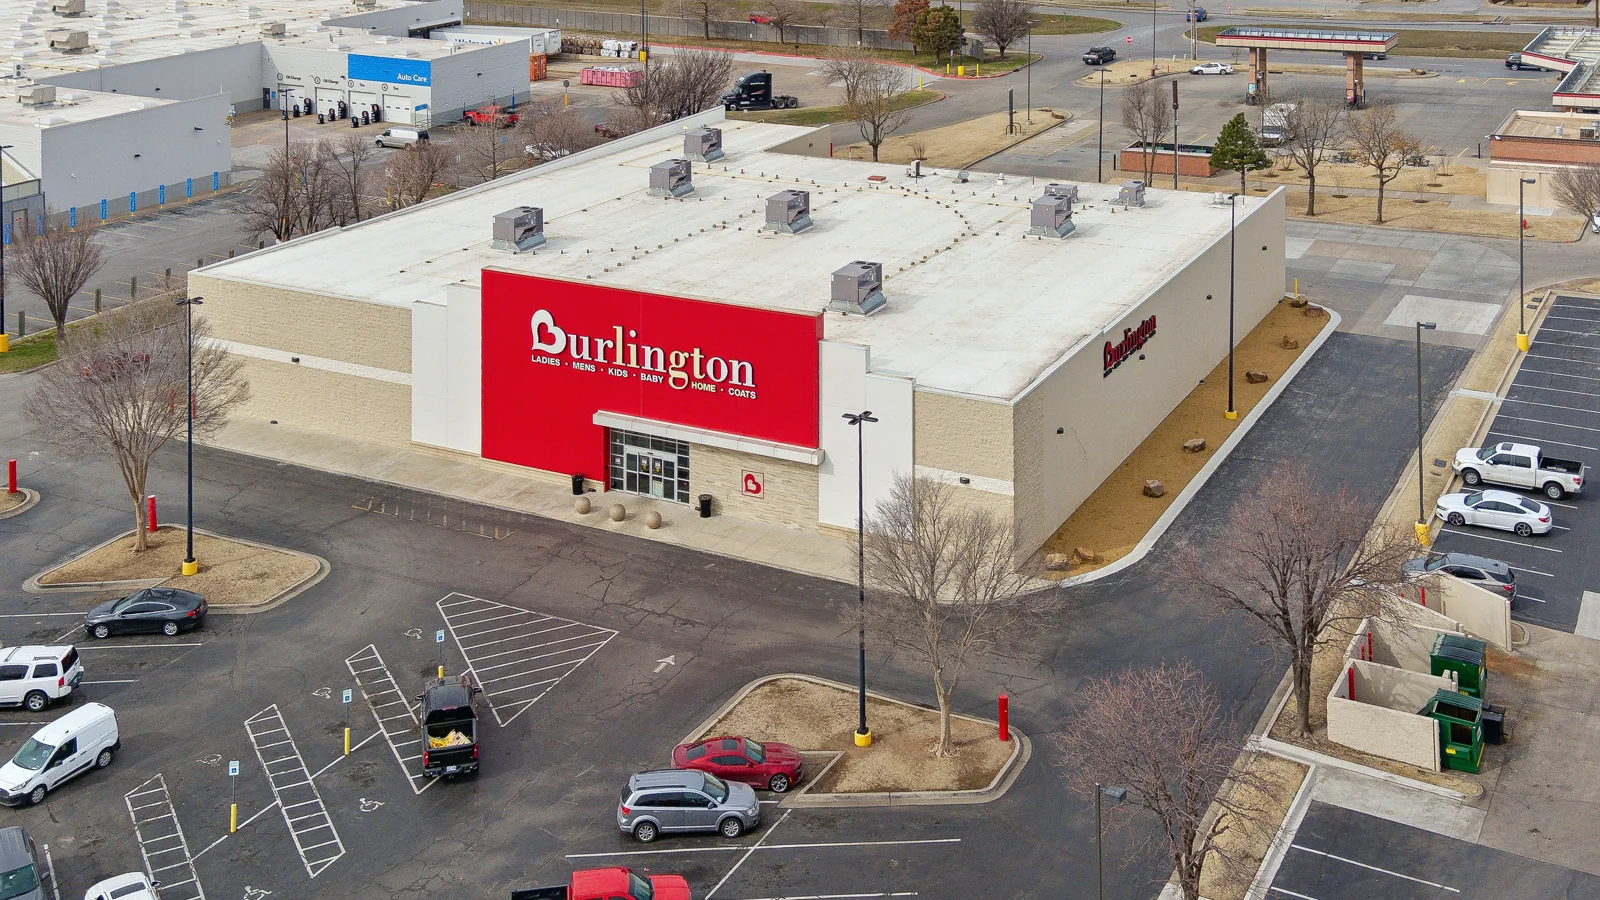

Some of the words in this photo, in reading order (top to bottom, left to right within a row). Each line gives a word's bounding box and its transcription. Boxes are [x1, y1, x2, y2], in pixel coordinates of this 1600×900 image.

[397, 73, 412, 82] Auto
[413, 74, 428, 83] Care
[530, 308, 756, 391] Burlington
[531, 354, 561, 367] LADIES
[572, 361, 596, 373] MENS
[608, 367, 629, 378] KIDS
[640, 372, 664, 384] BABY
[691, 381, 716, 393] HOME
[728, 387, 757, 399] COATS
